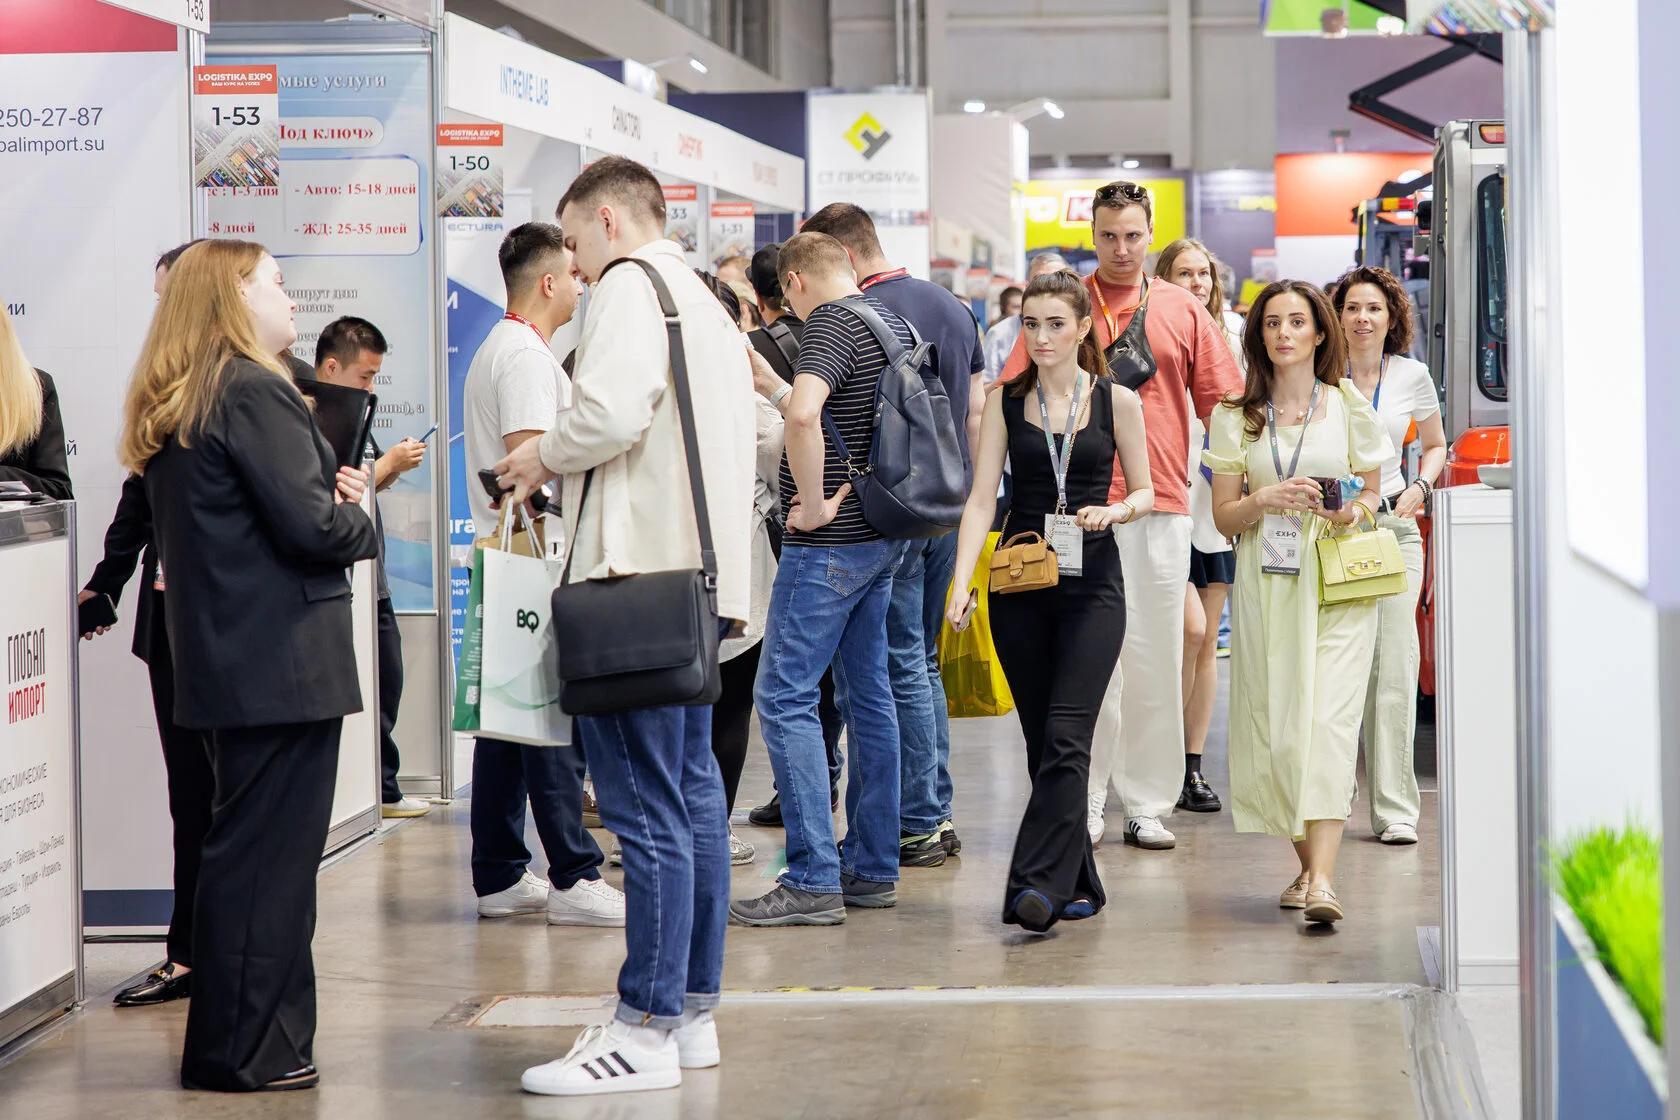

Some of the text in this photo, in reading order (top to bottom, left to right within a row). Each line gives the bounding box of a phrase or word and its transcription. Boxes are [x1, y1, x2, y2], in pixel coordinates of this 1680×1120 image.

[198, 72, 273, 82] LOGISTIKA EXPO
[322, 74, 387, 92] услуги
[212, 106, 260, 126] 1-53
[313, 129, 374, 141] ключ»
[440, 129, 500, 138] LOGISTIKA EXPO
[450, 156, 490, 171] 1-50
[304, 184, 342, 196] Авто:
[347, 184, 382, 195] 15-18
[385, 183, 417, 196] дней
[223, 222, 255, 234] дней
[303, 223, 332, 236] ЖД:
[337, 223, 372, 234] 25-35
[375, 222, 408, 235] дней
[516, 608, 540, 634] BQ
[8, 627, 46, 685] ГЛОБАЛ
[8, 682, 46, 725] ИМПОРТ
